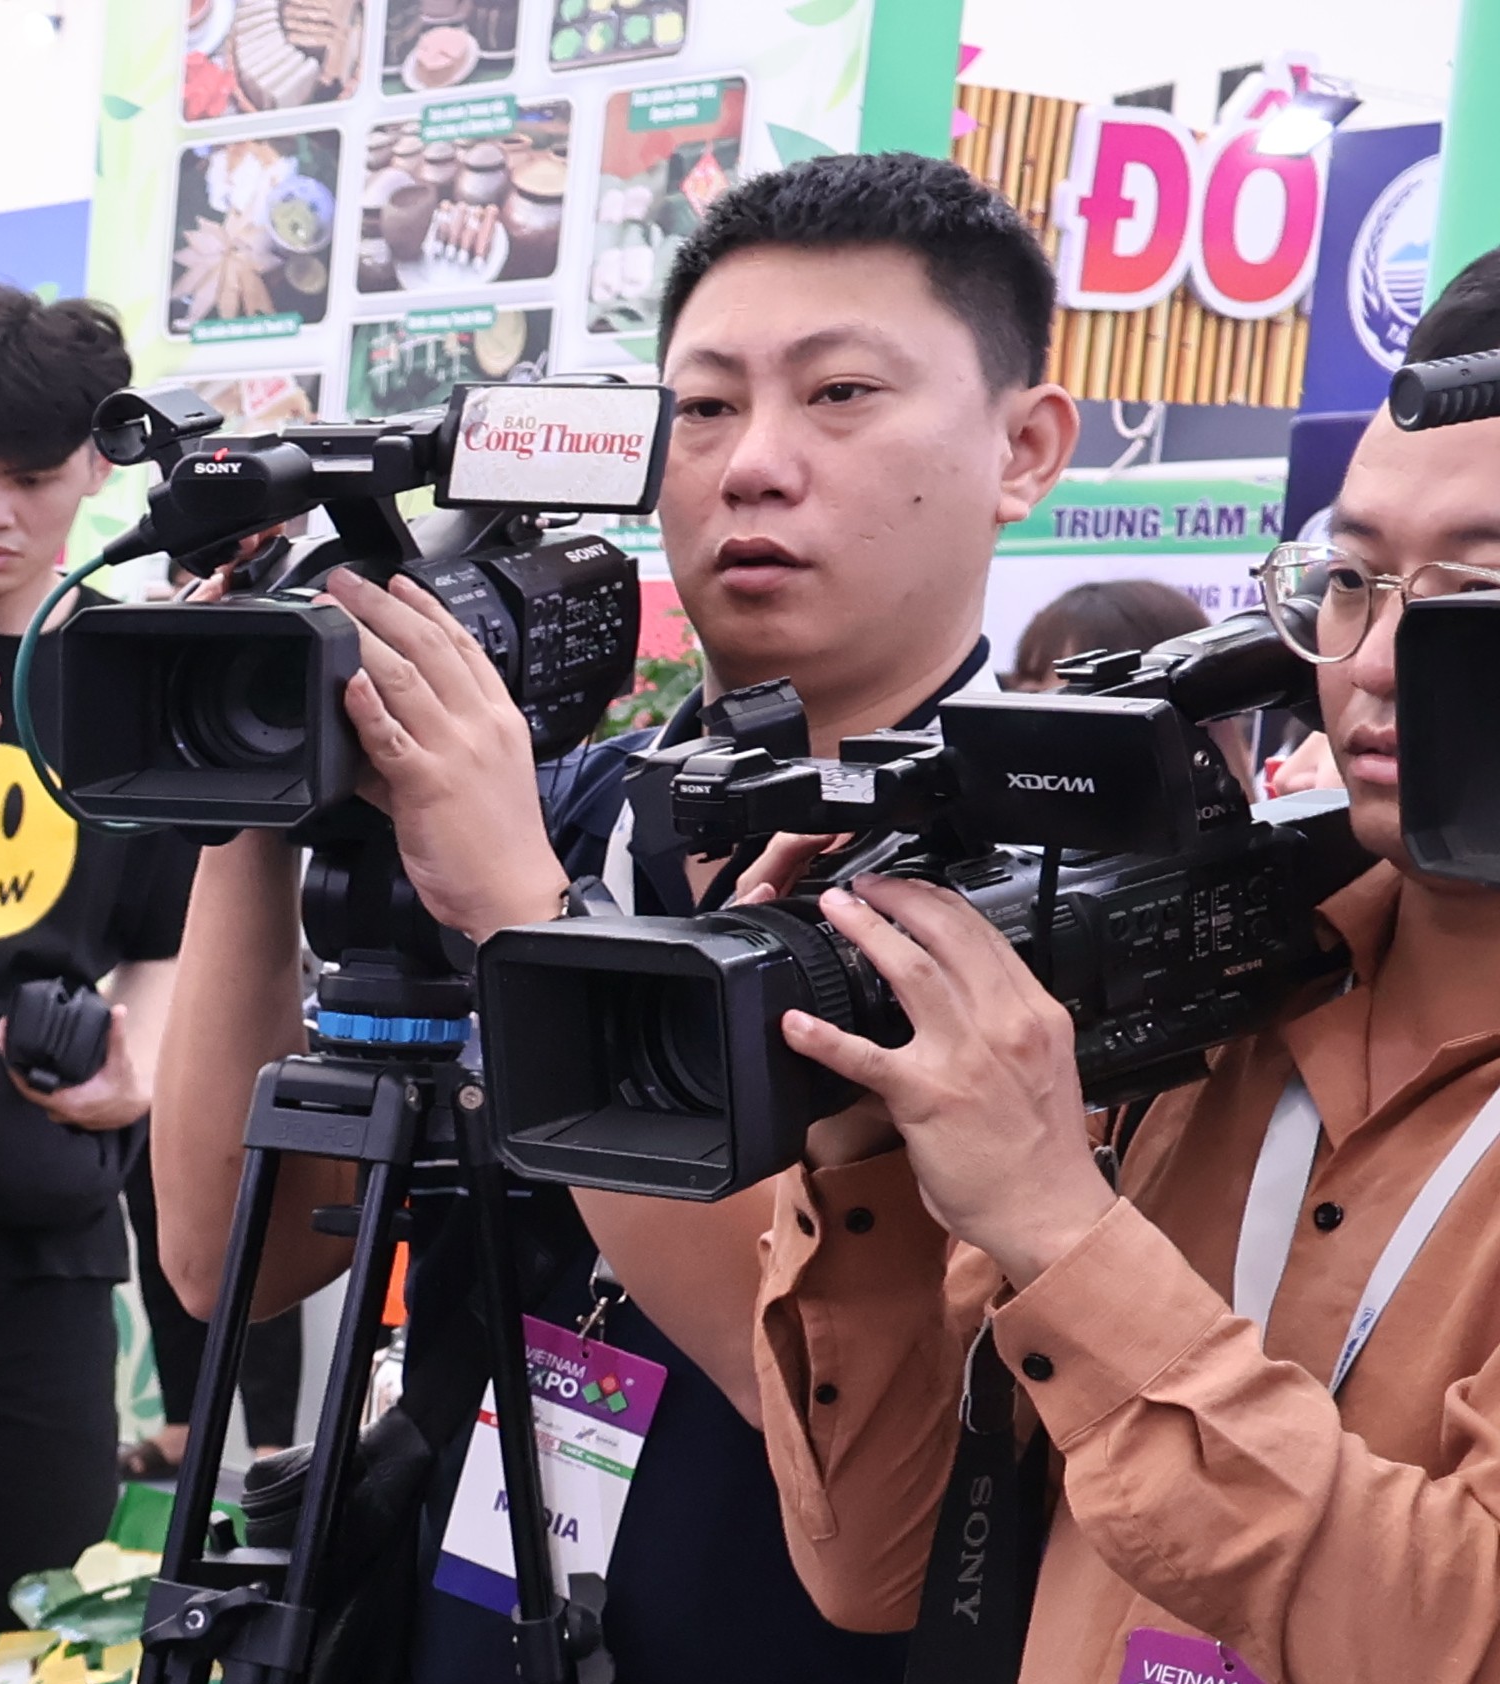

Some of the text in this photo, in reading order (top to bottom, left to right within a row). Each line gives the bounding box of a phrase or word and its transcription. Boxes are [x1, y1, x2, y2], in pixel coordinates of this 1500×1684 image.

[193, 461, 242, 476] SONY
[1052, 505, 1162, 540] TRUNG
[1174, 498, 1248, 538] TÂM
[564, 543, 609, 564] SONY
[679, 783, 712, 795] SONY
[1006, 772, 1096, 794] XDCAM
[952, 1474, 993, 1625] SONY
